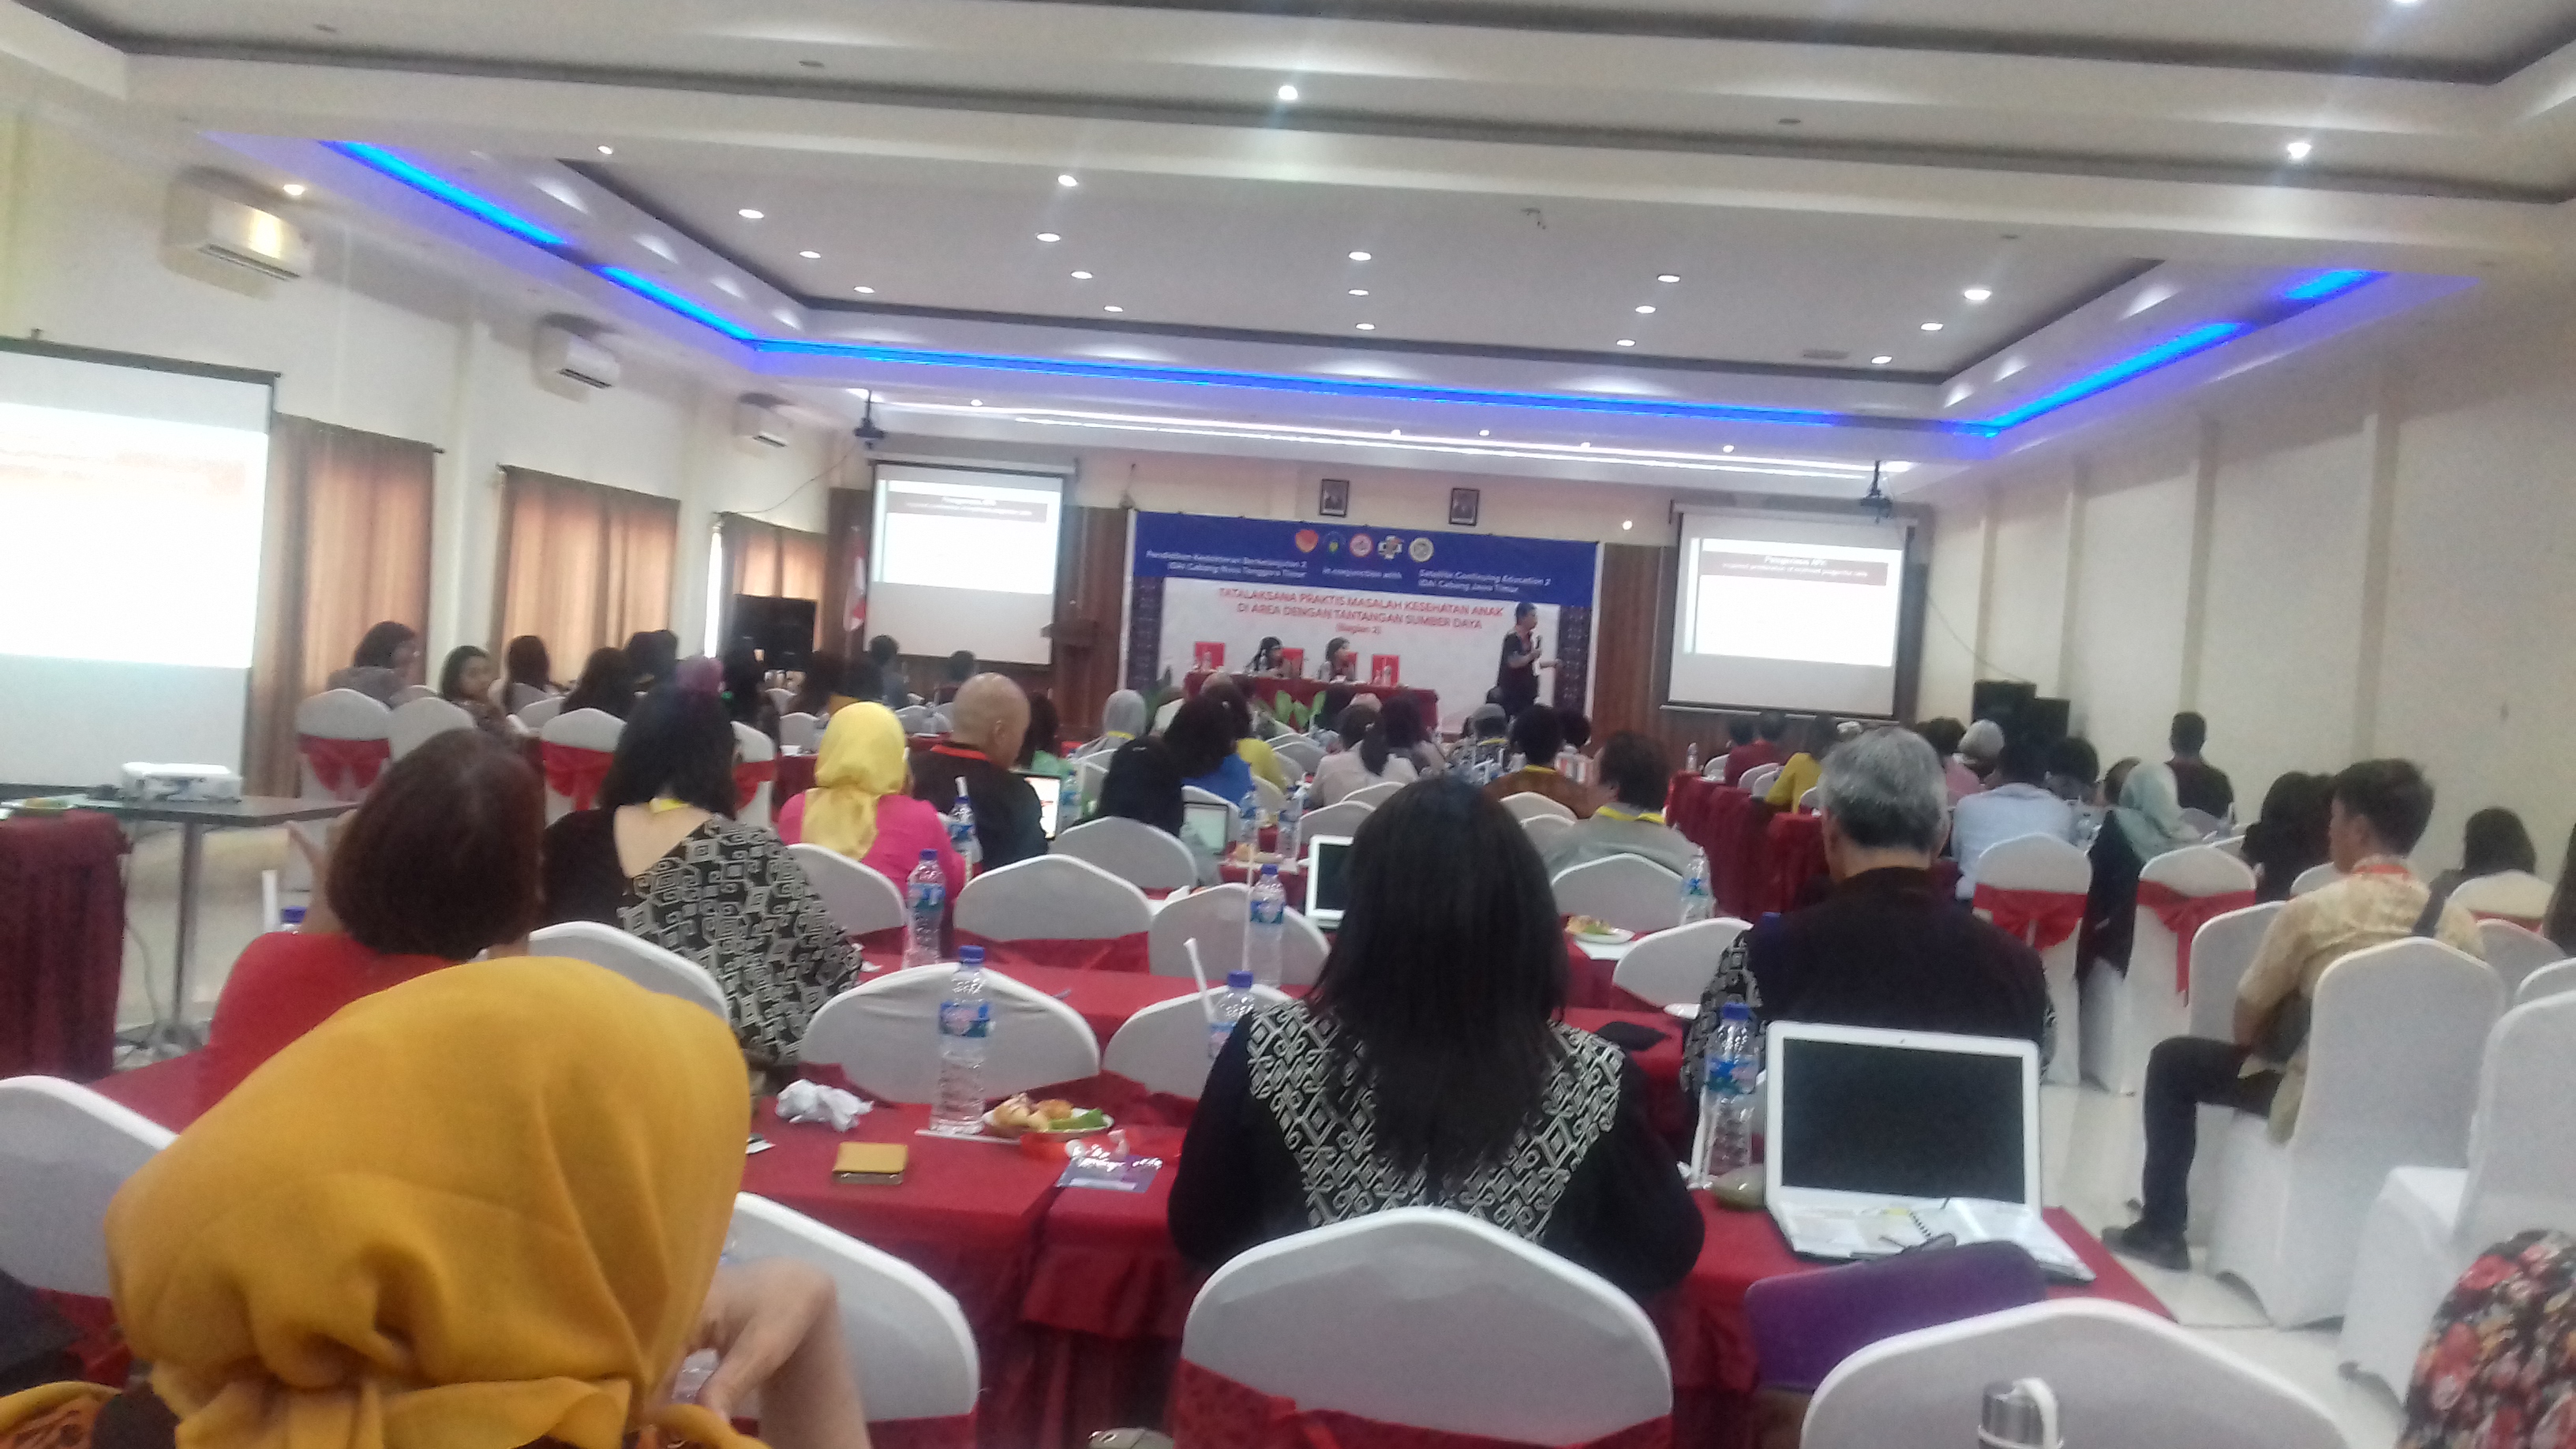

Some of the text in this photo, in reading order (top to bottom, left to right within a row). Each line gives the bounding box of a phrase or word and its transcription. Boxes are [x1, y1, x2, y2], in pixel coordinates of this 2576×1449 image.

[1437, 580, 1470, 592] Cabang
[1454, 571, 1500, 584] Continuing
[1501, 575, 1544, 586] Education
[1219, 587, 1504, 617] TATALAKSANA PRAKTIS MASALAH KESEHATAN ANAK
[1237, 602, 1482, 630] DI AREA DENGAN TANTANGAN SUMBER DAYA
